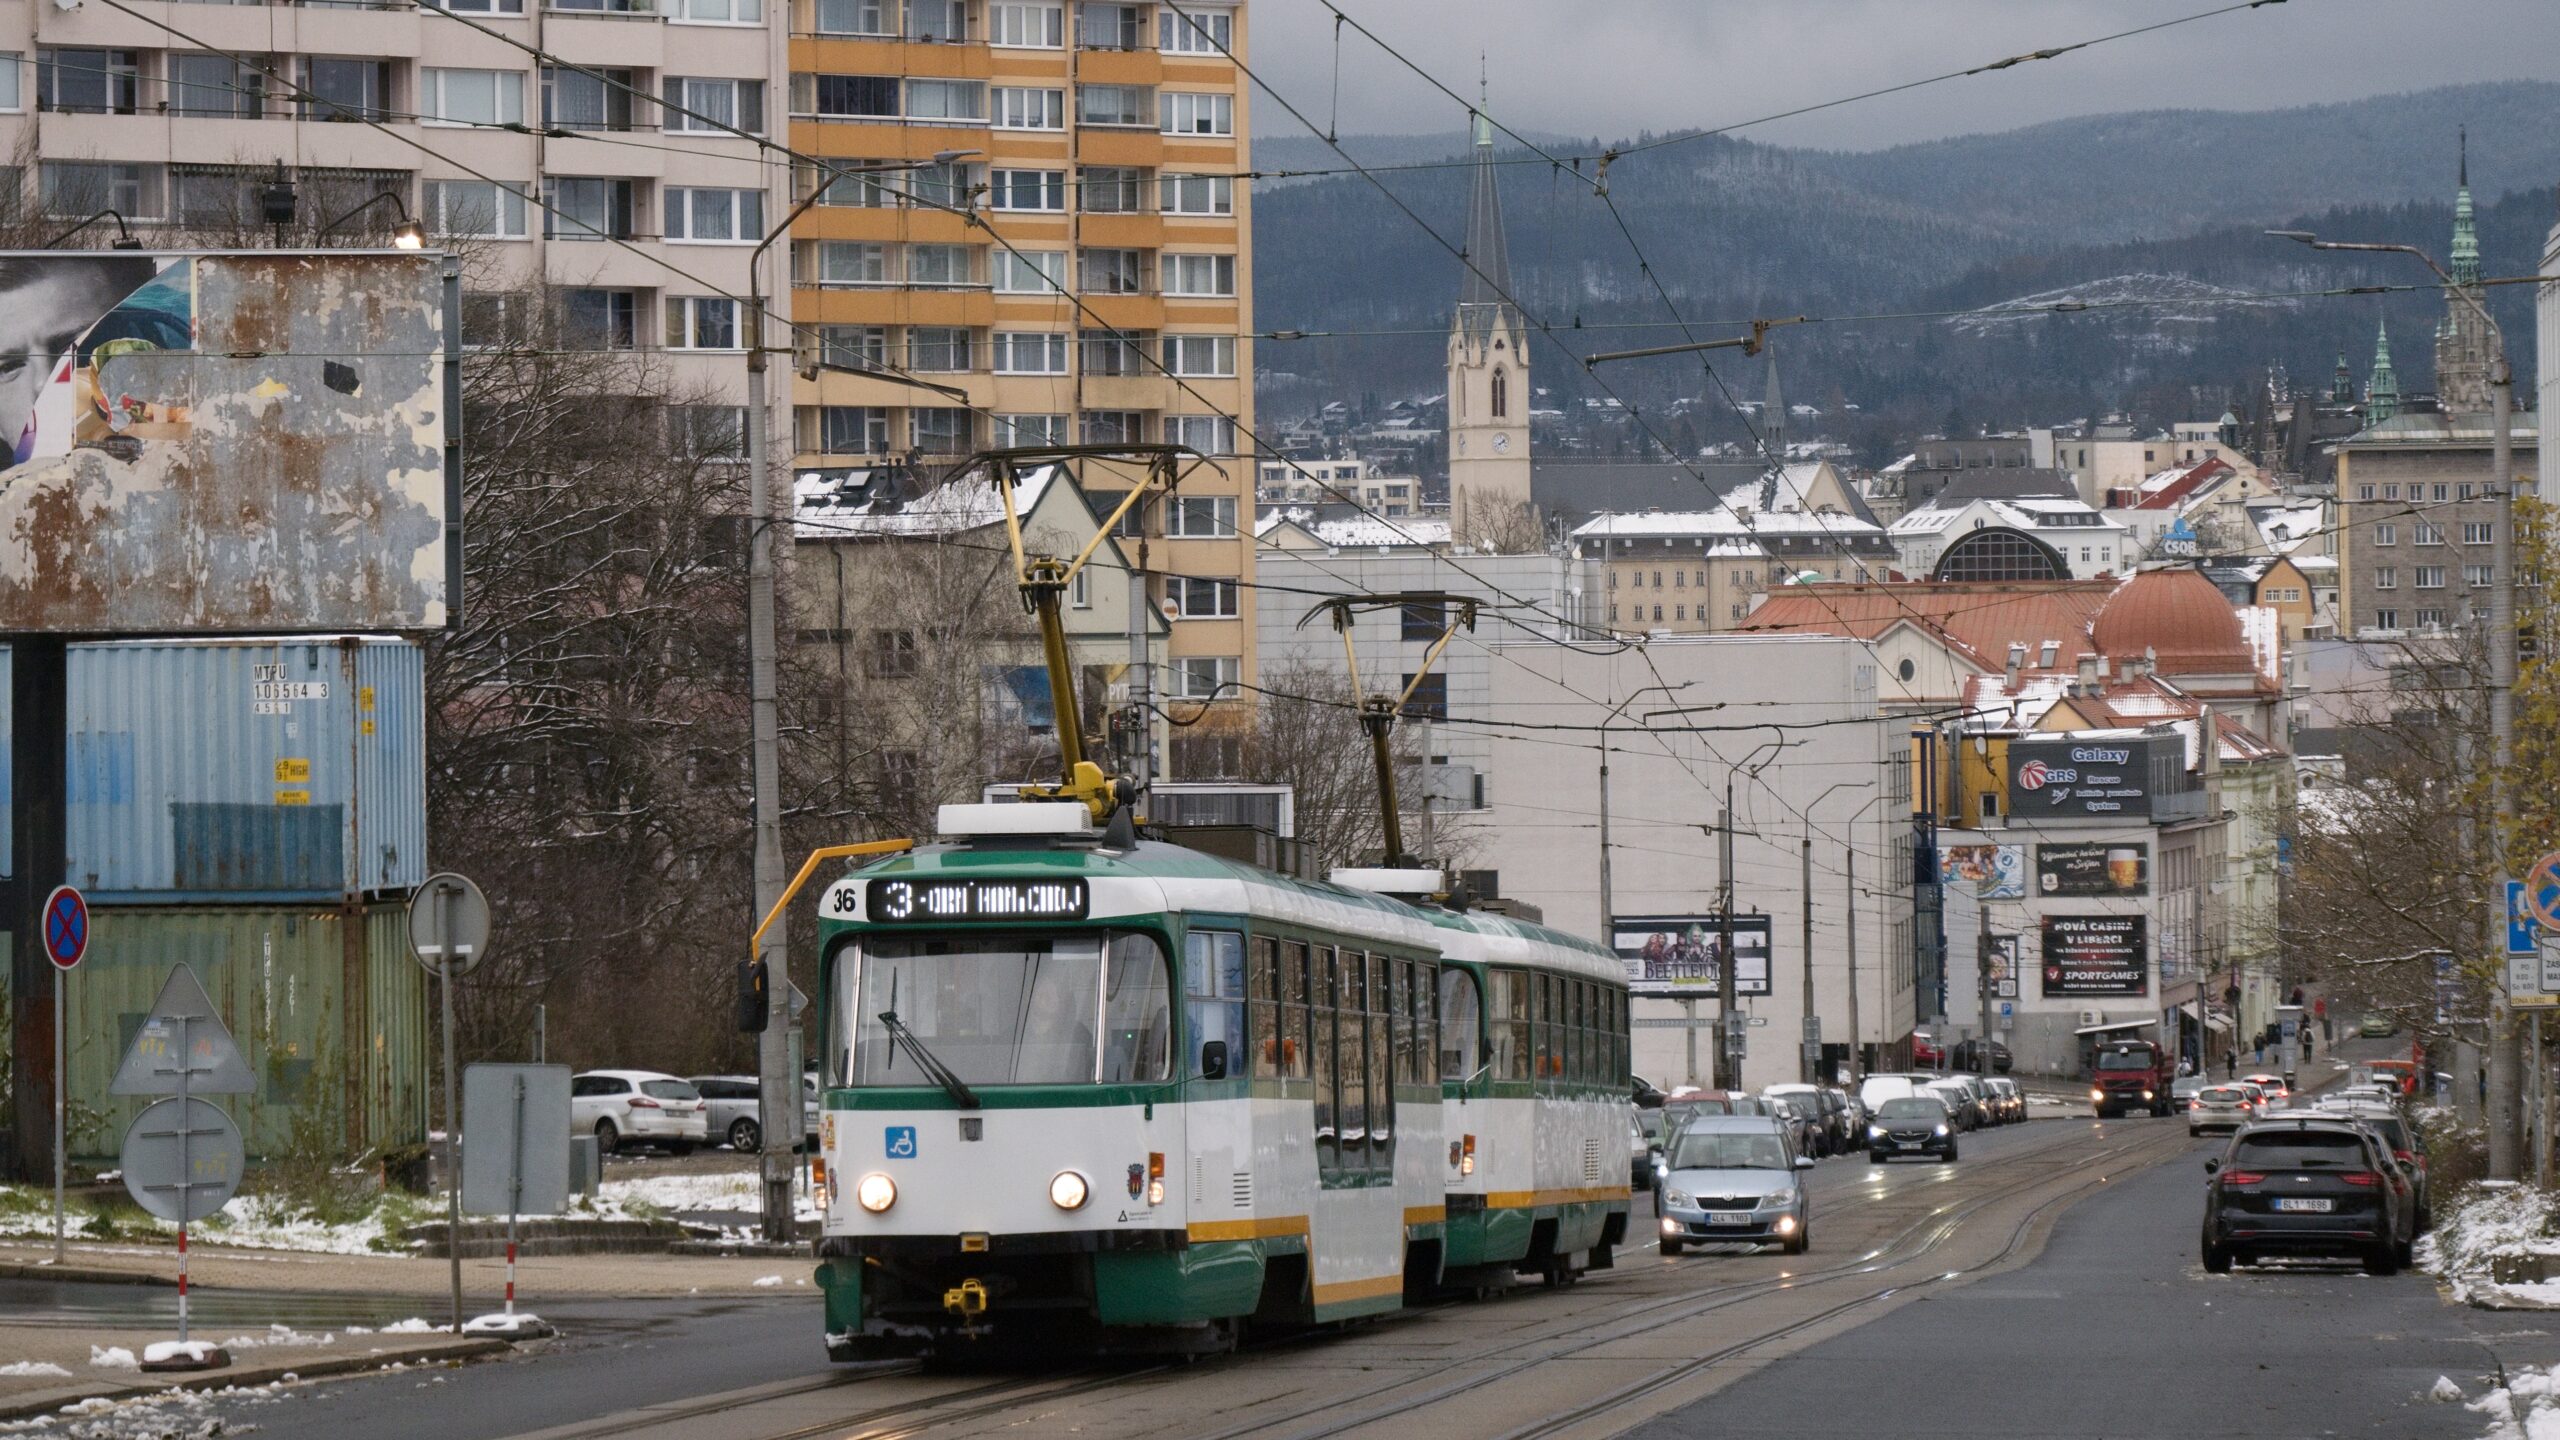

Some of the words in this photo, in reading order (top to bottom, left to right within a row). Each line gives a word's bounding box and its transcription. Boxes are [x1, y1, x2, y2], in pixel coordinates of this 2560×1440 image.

[254, 684, 308, 699] 106564
[320, 683, 328, 698] 3
[2072, 747, 2129, 765] Galaxy
[2045, 769, 2077, 783] GRS
[2087, 775, 2121, 784] Rescue
[2087, 802, 2121, 811] System
[833, 888, 856, 913] 36
[887, 882, 912, 918] 3
[2055, 920, 2087, 931] NOVÁ
[2089, 922, 2133, 931] CASINA
[2066, 935, 2074, 944] V
[2077, 935, 2123, 944] LIBERCI
[1645, 959, 1739, 979] BEETLEJUIE
[2065, 971, 2139, 980] SPORTGAMES
